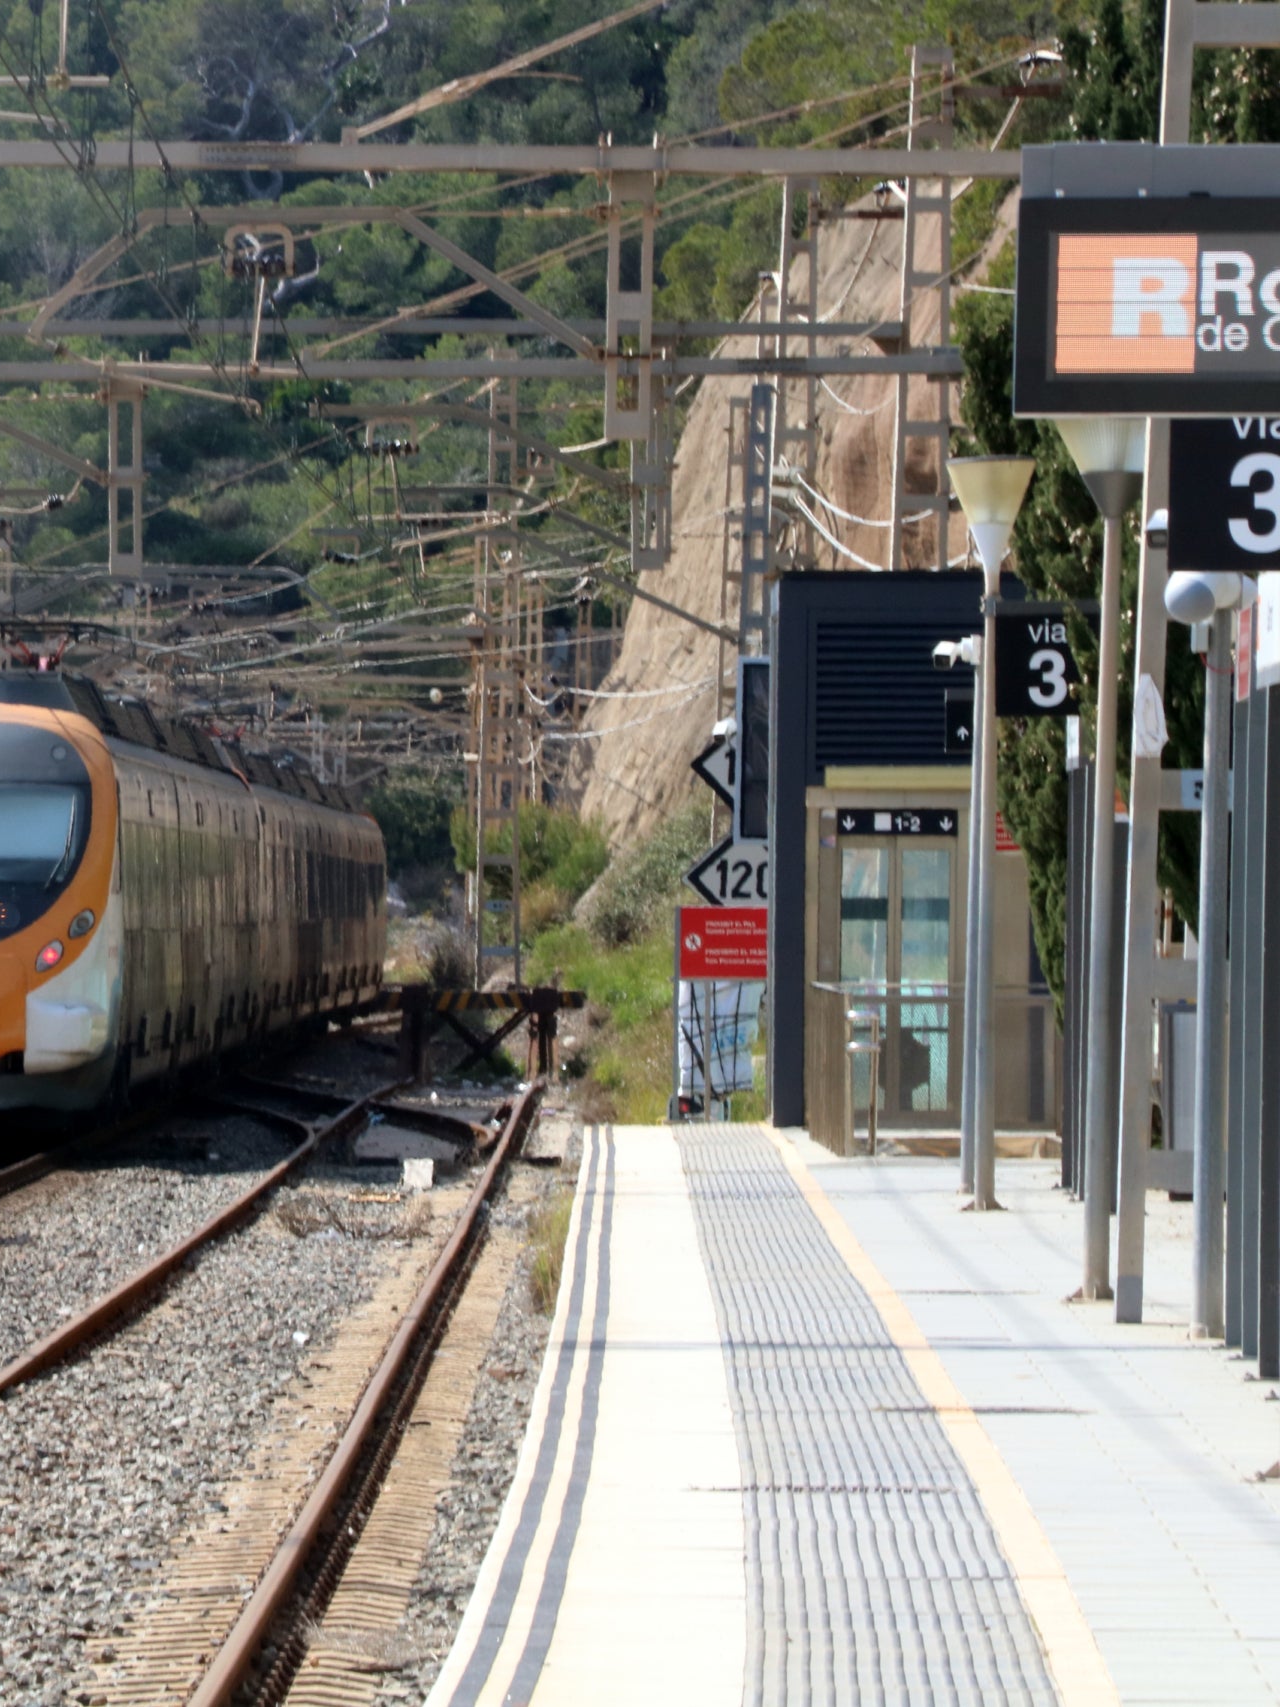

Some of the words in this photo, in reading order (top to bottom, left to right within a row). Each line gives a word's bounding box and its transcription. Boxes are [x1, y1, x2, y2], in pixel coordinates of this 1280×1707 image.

[1111, 257, 1190, 338] R
[1196, 315, 1250, 352] de
[1228, 452, 1280, 554] 3
[1028, 618, 1068, 644] via
[1028, 649, 1068, 708] 3
[894, 816, 921, 832] 1-2
